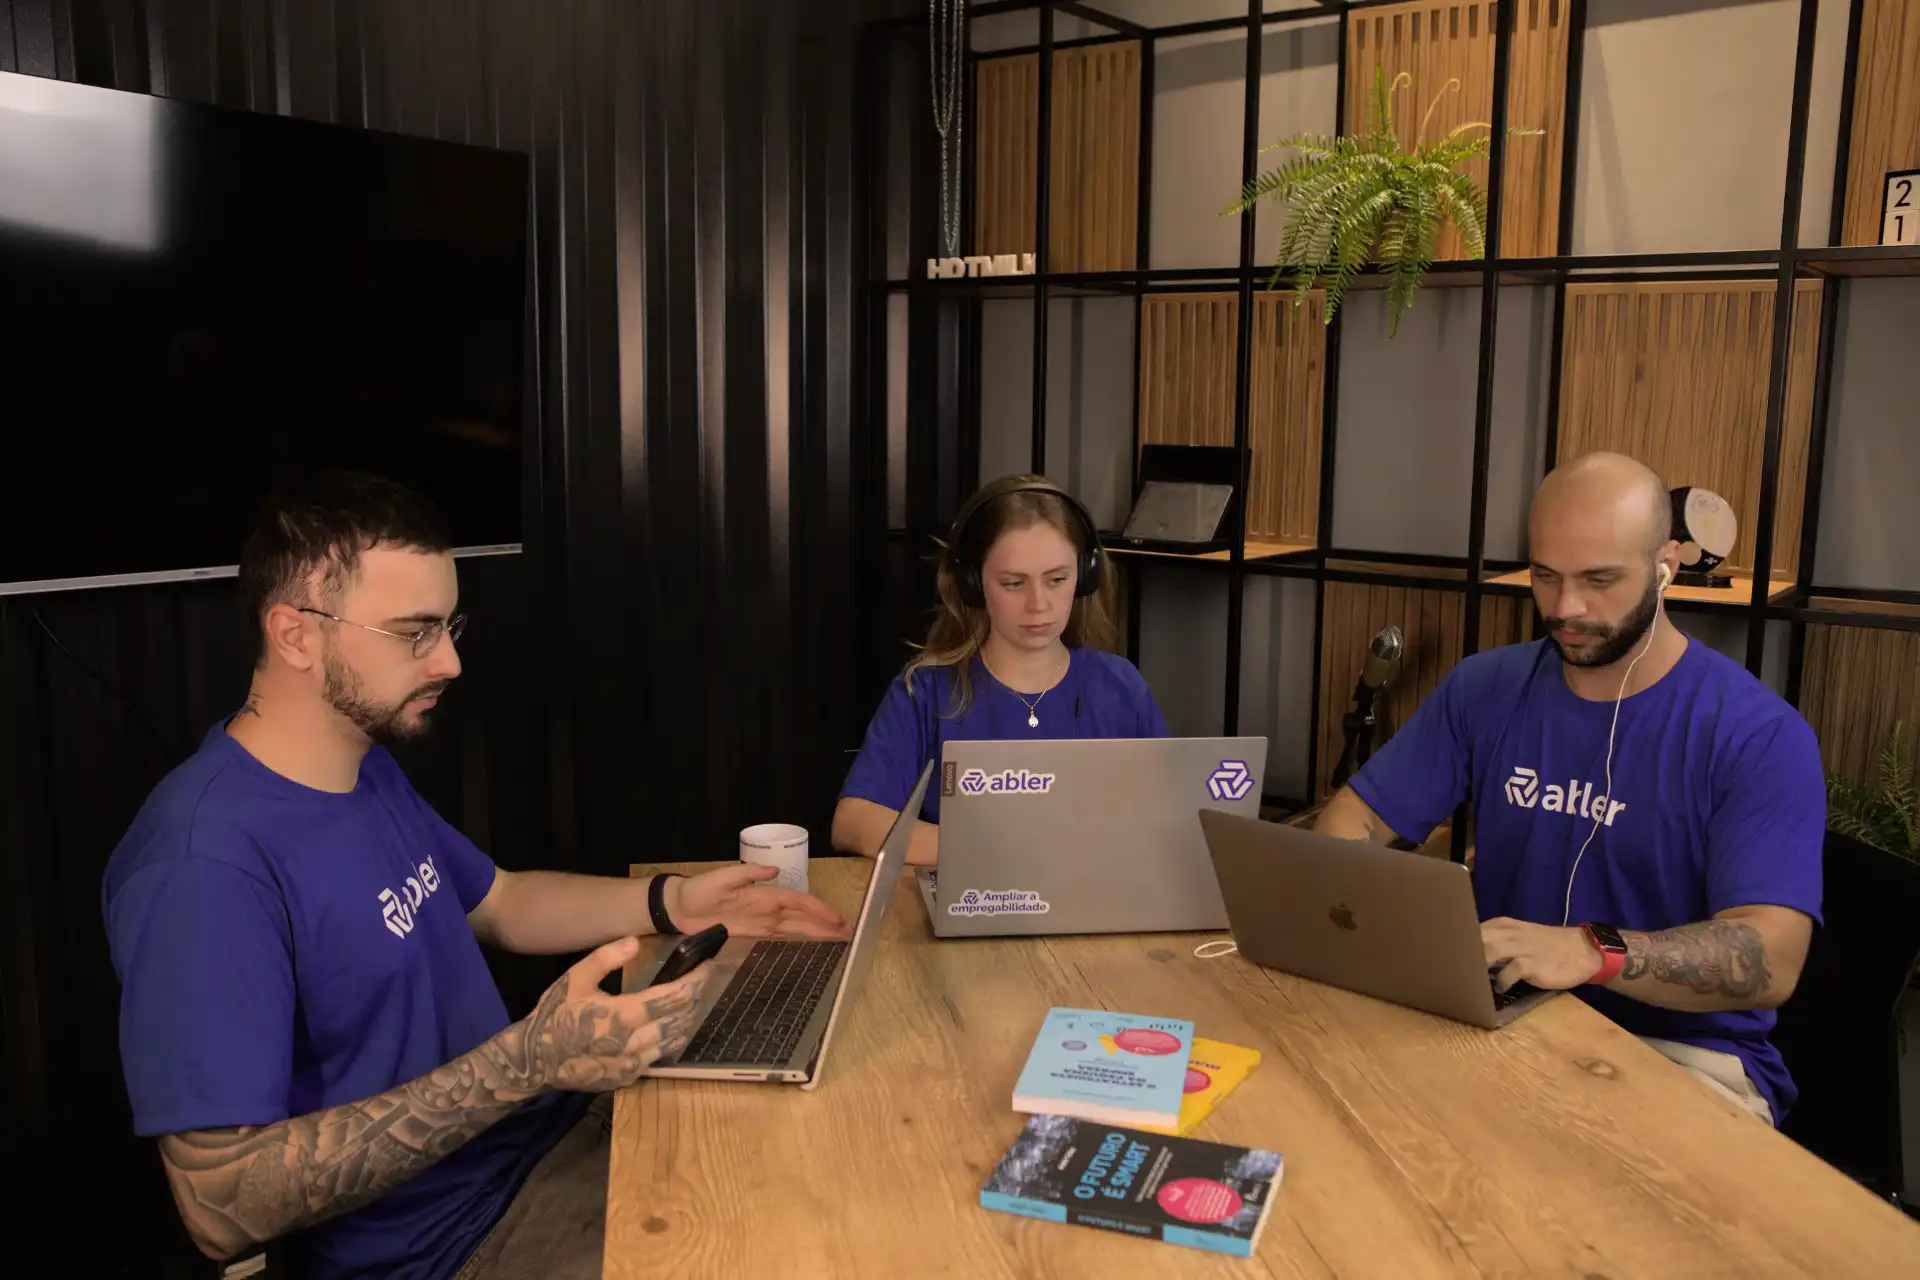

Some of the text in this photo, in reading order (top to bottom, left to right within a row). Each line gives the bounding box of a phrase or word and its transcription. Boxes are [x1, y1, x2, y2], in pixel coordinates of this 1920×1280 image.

[1894, 179, 1912, 208] 2
[1894, 215, 1904, 242] 1
[990, 772, 1052, 791] abler
[951, 902, 1047, 914] empregabilidade
[983, 892, 1037, 905] Ampliar a
[1080, 1132, 1127, 1187] FUTURO
[1110, 1140, 1151, 1188] SMART
[1073, 1184, 1096, 1200] O
[1100, 1185, 1127, 1200] É
